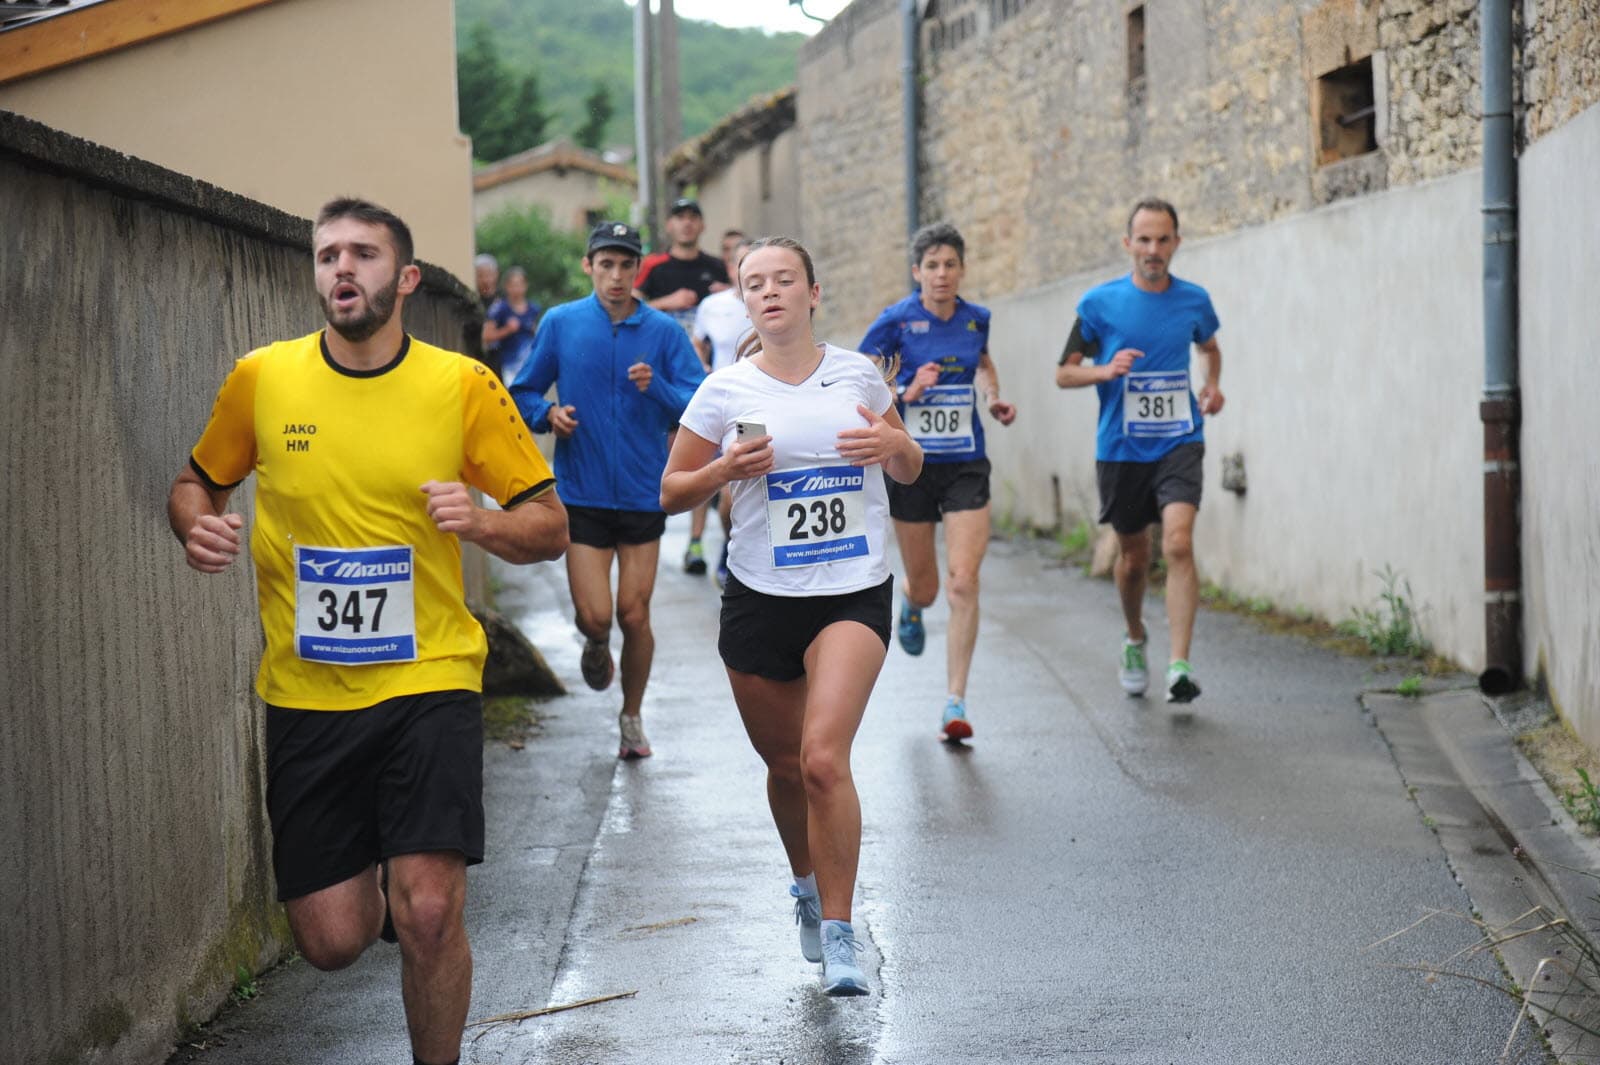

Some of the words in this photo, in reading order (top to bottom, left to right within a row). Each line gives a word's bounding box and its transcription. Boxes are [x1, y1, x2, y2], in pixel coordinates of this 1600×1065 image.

[1138, 395, 1174, 418] 381
[282, 424, 317, 434] JAKO
[920, 410, 960, 433] 308
[286, 439, 309, 452] HM
[788, 498, 846, 540] 238
[786, 542, 855, 558] www.mizunoexpert.fr
[317, 588, 388, 633] 347
[311, 642, 398, 654] www.mizunoexpert.fr
